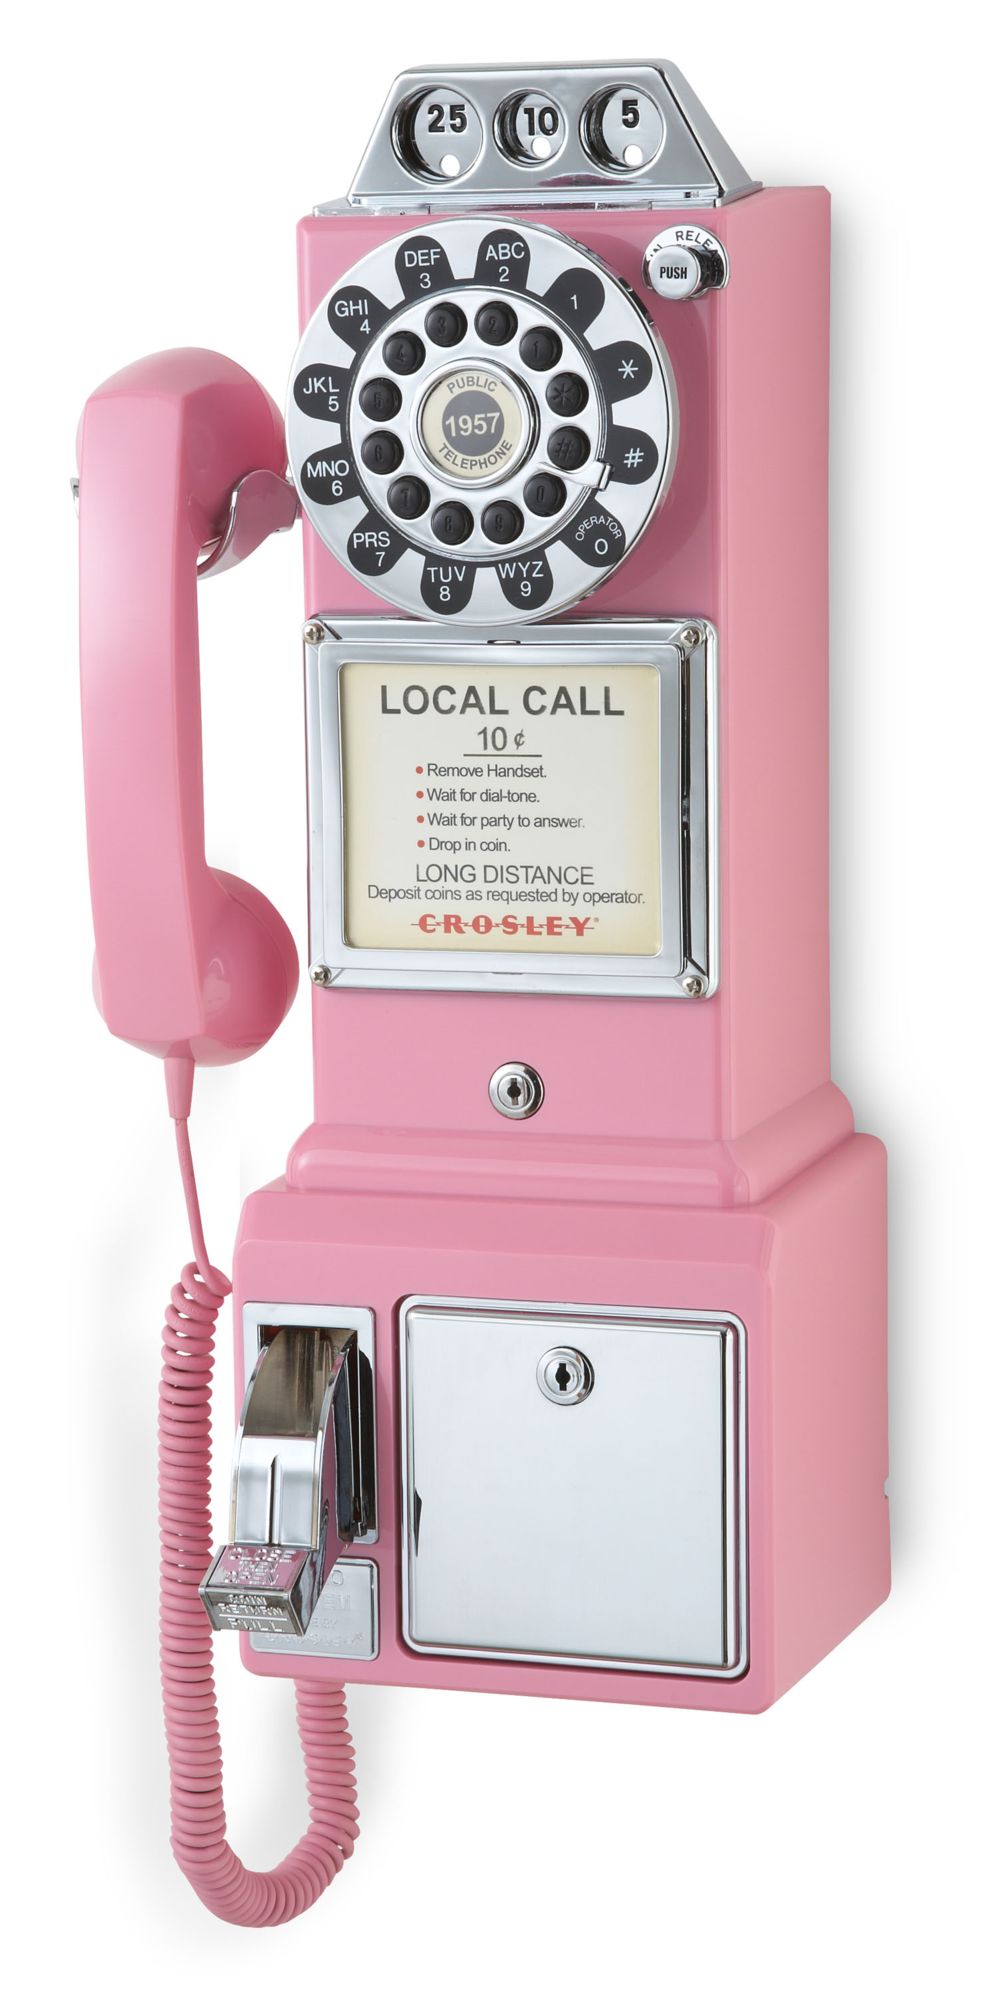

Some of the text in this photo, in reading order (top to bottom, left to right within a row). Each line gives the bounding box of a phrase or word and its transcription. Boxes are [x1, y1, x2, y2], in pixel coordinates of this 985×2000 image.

[427, 103, 468, 133] 25
[523, 107, 559, 136] 10
[621, 99, 640, 129] 5
[404, 248, 441, 267] DEF
[485, 241, 525, 261] ABC
[419, 273, 432, 289] 3
[498, 265, 510, 282] 2
[659, 266, 688, 279] PUSH
[334, 299, 369, 317] GHI
[570, 294, 578, 310] 1
[359, 319, 371, 335] 4
[302, 376, 340, 394] JKL
[446, 376, 499, 394] PUBLIC
[328, 395, 339, 412] 5
[444, 412, 501, 437] 1957
[436, 438, 513, 471] TELEPHONE
[306, 459, 350, 477] MNO
[331, 480, 343, 497] 6
[574, 514, 622, 542] OPERATOR
[353, 531, 391, 548] PRS
[375, 551, 386, 567] 7
[427, 565, 467, 582] TUV
[498, 560, 544, 578] WYZ
[439, 585, 450, 601] 8
[520, 580, 532, 597] 9
[380, 684, 625, 716] LOCAL CALL
[476, 726, 526, 752] 10 ¢
[427, 764, 547, 779] Remove Handset.
[427, 788, 540, 804] Wait for dial-tone.
[427, 813, 585, 832] Wait for party to answer.
[429, 838, 511, 854] Drop in coin.
[416, 863, 595, 886] LONG DISTANCE
[368, 885, 646, 906] Deposit coins as requested by operator.
[227, 1594, 268, 1606] COIN
[217, 1603, 284, 1616] RETURN
[227, 1617, 284, 1632] PULL
